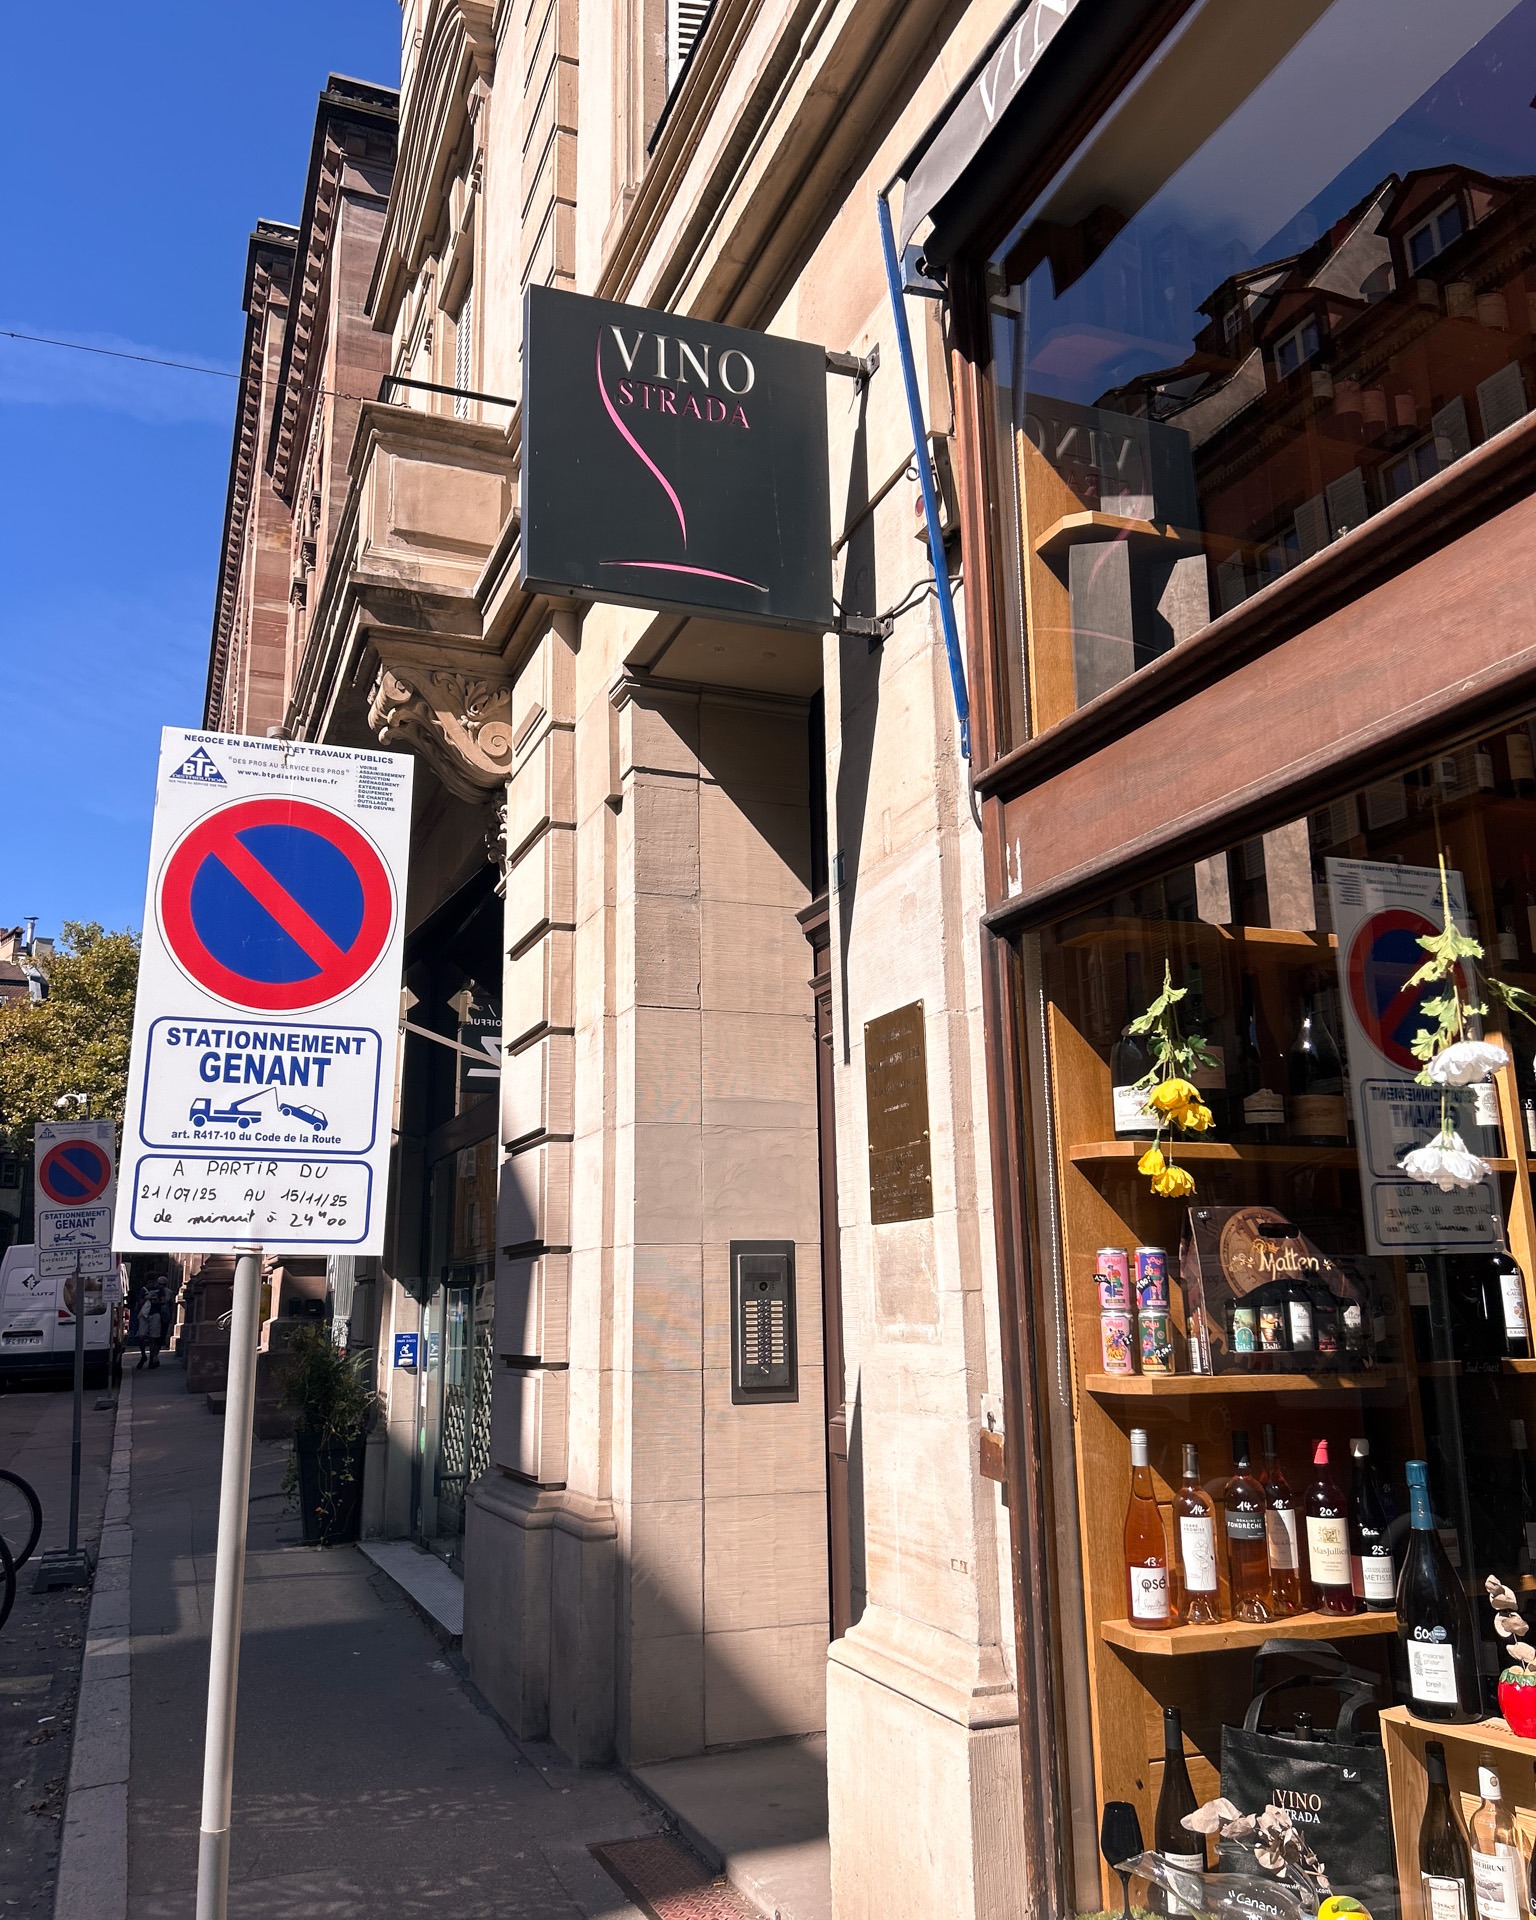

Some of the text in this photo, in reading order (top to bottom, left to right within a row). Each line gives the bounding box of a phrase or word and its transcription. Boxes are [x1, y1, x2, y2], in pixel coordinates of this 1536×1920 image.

[608, 323, 755, 395] VINO
[616, 377, 751, 430] STRADA
[184, 734, 394, 765] NEGOCE EN BATIMENT ET TRAVAUX PUBLICS
[248, 760, 267, 768] PROS
[311, 766, 325, 774] DES
[237, 769, 338, 785] www.btpdistribution.fr
[166, 1026, 367, 1055] STATIONNEMENT
[199, 1051, 332, 1088] GENANT
[171, 1130, 342, 1145] art. R417-10 du Code de la Route
[172, 1160, 185, 1177] A
[299, 1163, 329, 1179] DU
[141, 1184, 348, 1208] 21/07/25 AU 15/11/25
[44, 1210, 106, 1220] STATIONNEMENT
[55, 1218, 96, 1230] GENANT
[153, 1208, 172, 1224] de
[187, 1209, 254, 1226] minuit
[1258, 1245, 1320, 1280] Matten
[1465, 1361, 1500, 1373] Sud-Ouest
[1275, 1788, 1322, 1812] VINO
[1284, 1808, 1321, 1824] TRADA
